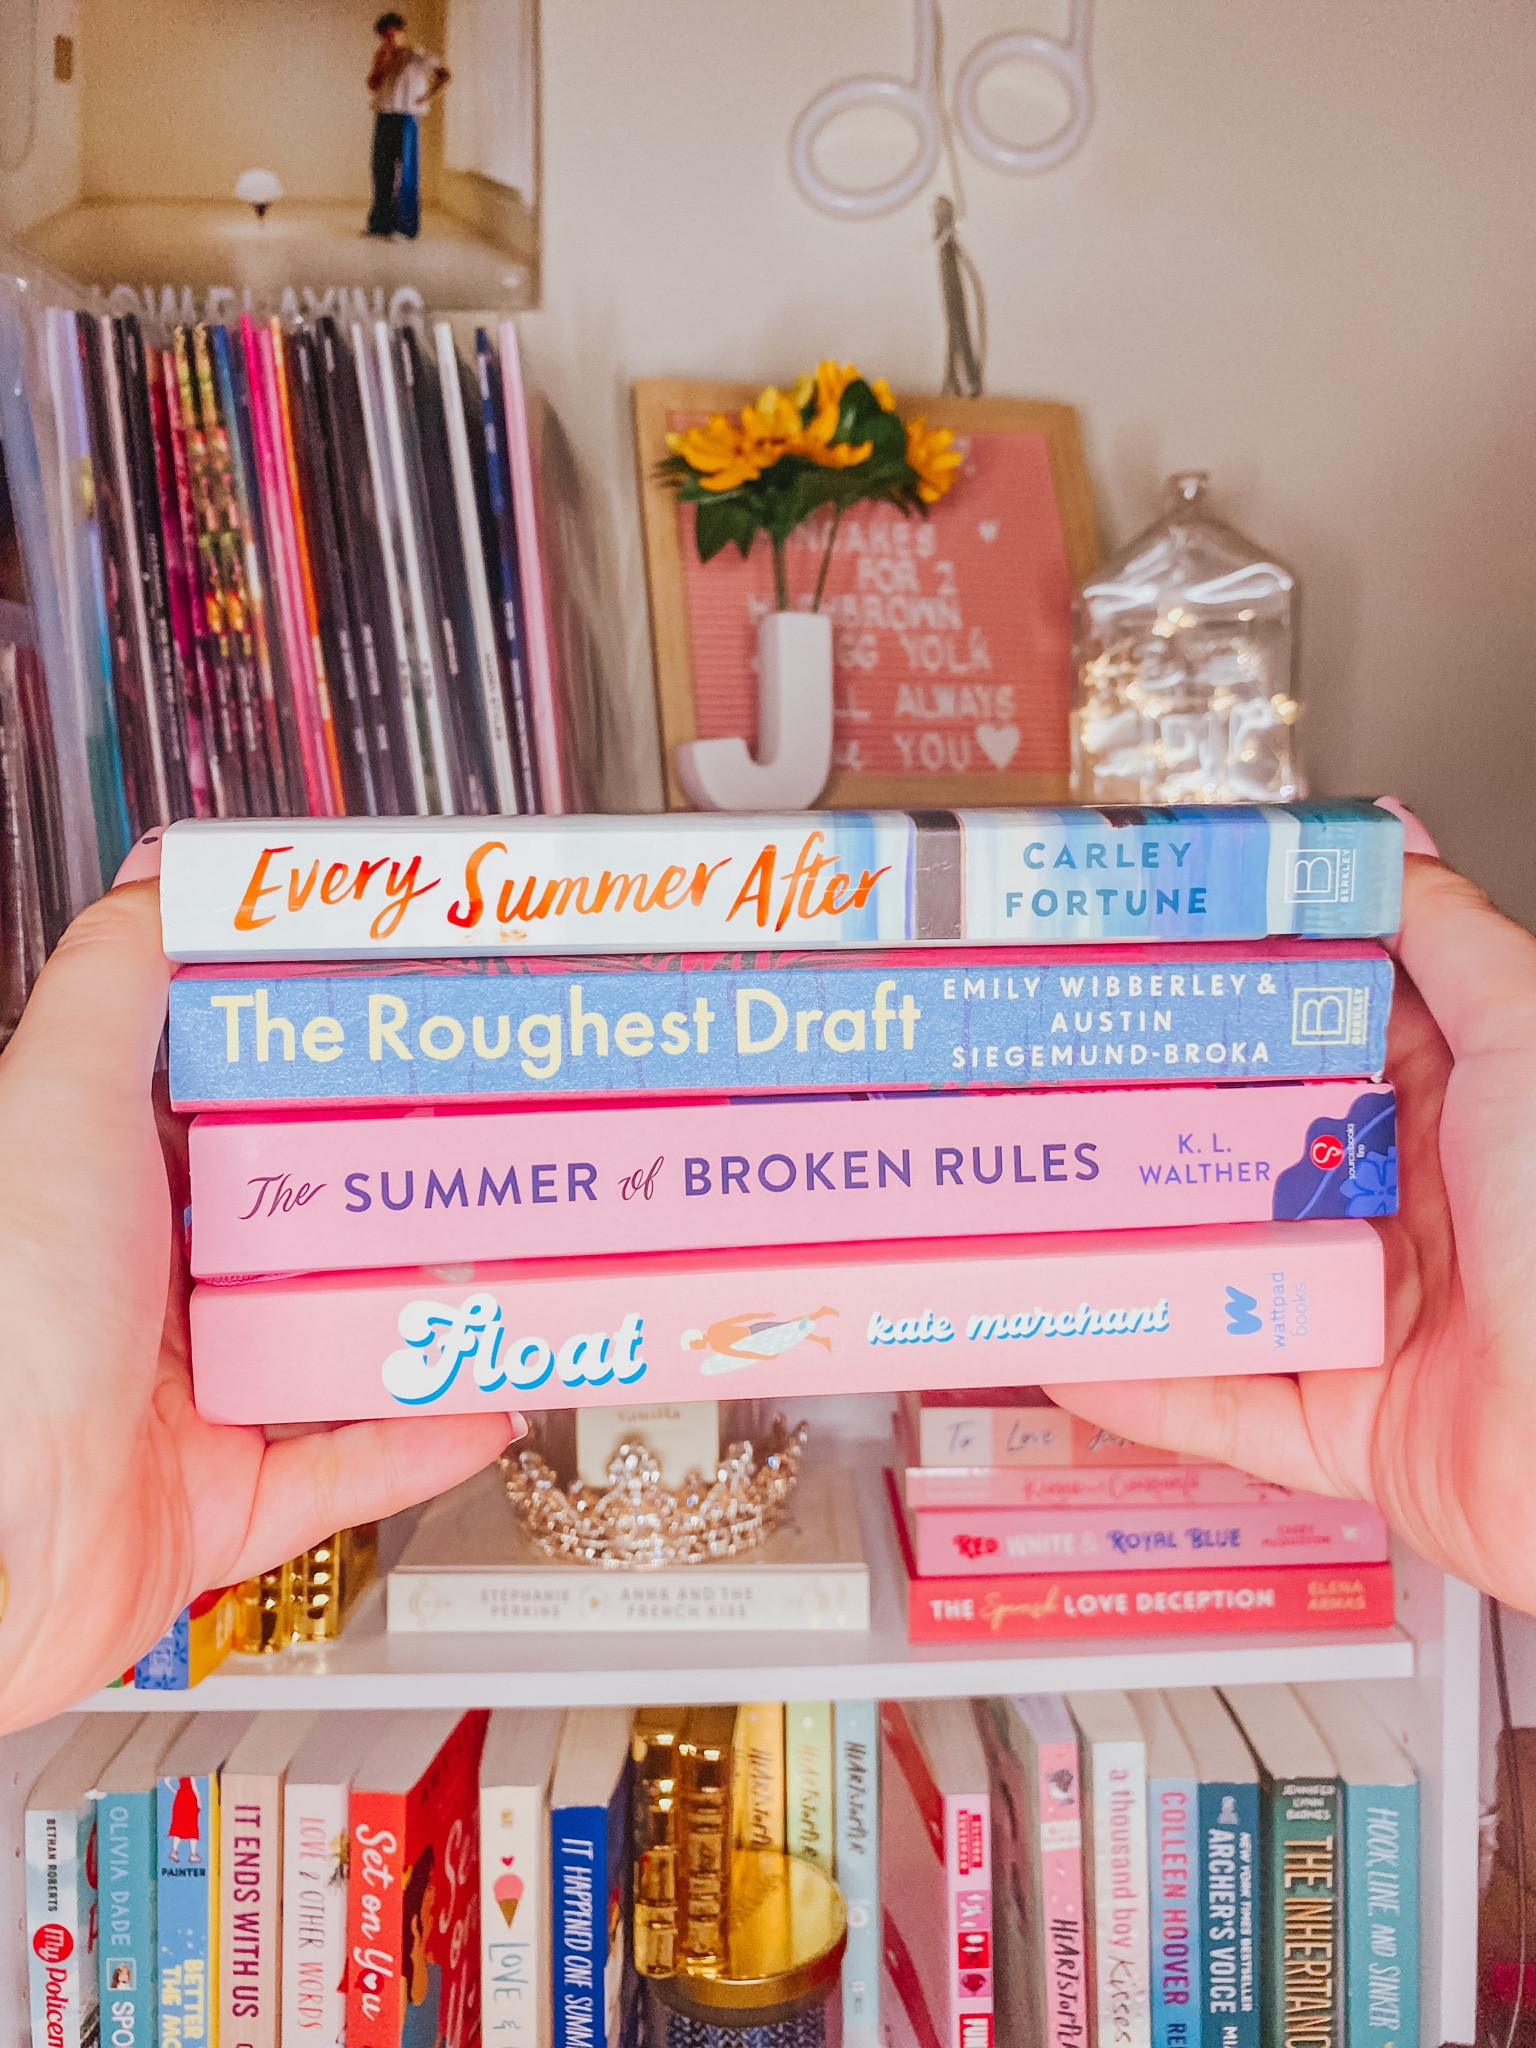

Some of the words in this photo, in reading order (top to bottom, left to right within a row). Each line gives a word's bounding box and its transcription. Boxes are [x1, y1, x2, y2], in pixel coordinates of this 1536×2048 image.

[894, 684, 1017, 722] ALWAYS
[893, 731, 973, 772] YOU
[1022, 841, 1193, 871] CARLEY
[1340, 848, 1352, 903] BERKLEY
[233, 845, 442, 941] Every
[446, 840, 733, 929] Summer
[725, 830, 893, 933] After
[1005, 886, 1208, 918] FORTUNE
[943, 976, 1041, 1000] EMILY
[1059, 973, 1247, 998] WIBBERLEY
[1257, 973, 1278, 996] &
[210, 988, 346, 1063] The
[367, 984, 716, 1080] Roughest
[736, 979, 922, 1055] Draft
[1050, 1009, 1173, 1034] AUSTIN
[1351, 987, 1364, 1046] BERKLEY
[951, 1041, 1270, 1069] SIEGEMUND-BROKA
[1177, 1133, 1203, 1155] K.
[1211, 1132, 1233, 1153] L.
[1345, 1122, 1356, 1180] sourcebooks
[237, 1172, 328, 1221] The
[343, 1161, 599, 1214] SUMMER
[617, 1155, 666, 1202] of
[684, 1148, 912, 1197] BROKEN
[934, 1142, 1101, 1186] RULES
[1138, 1160, 1271, 1186] WALTHER
[1268, 1271, 1289, 1350] wattpad
[1291, 1281, 1309, 1337] books
[381, 1292, 648, 1406] Float
[866, 1308, 955, 1346] kate
[965, 1297, 1170, 1342] marchant
[1006, 1418, 1058, 1452] Love
[952, 1532, 1000, 1560] RED
[1105, 1529, 1178, 1554] ROYAL
[1184, 1527, 1242, 1551] BLUE
[675, 1584, 716, 1601] AND
[721, 1584, 754, 1602] THE
[931, 1598, 975, 1621] THE
[1063, 1592, 1130, 1618] LOVE
[1135, 1587, 1276, 1615] DECEPTION
[1108, 1768, 1131, 1782] a
[46, 1817, 58, 1860] BETHAN
[234, 1804, 261, 1828] IT
[298, 1816, 327, 1861] LOVE
[108, 1805, 130, 1884] OLIVIA
[233, 1835, 261, 1903] ENDS
[354, 1823, 398, 1889] Set
[560, 1837, 595, 1861] IT
[1108, 1788, 1139, 1902] thousand
[1159, 1790, 1189, 1899] COLLEEN
[1283, 1835, 1334, 1889] THE
[46, 1864, 59, 1913] ROBERTS
[160, 1866, 207, 1879] PAINTER
[1207, 1827, 1237, 1941] ARCHER'S
[110, 1889, 132, 1949] DADE
[298, 1890, 326, 1949] OTHER
[360, 1892, 382, 1941] on
[562, 1864, 595, 1954] HAPPENED
[1111, 1906, 1139, 1948] boy
[1240, 1900, 1253, 1936] TIMES
[231, 1911, 260, 1976] WITH
[1162, 1908, 1192, 2006] HOOVER
[1369, 1923, 1398, 1961] AND
[161, 1964, 183, 2006] THE
[296, 1961, 325, 2031] WORDS
[487, 1941, 531, 2003] LOVE
[562, 1954, 595, 1990] ONE
[1208, 1945, 1238, 2014] VOICE
[183, 1958, 205, 2040] BETTER
[231, 1984, 260, 2019] US
[1367, 1963, 1402, 2033] SINKER
